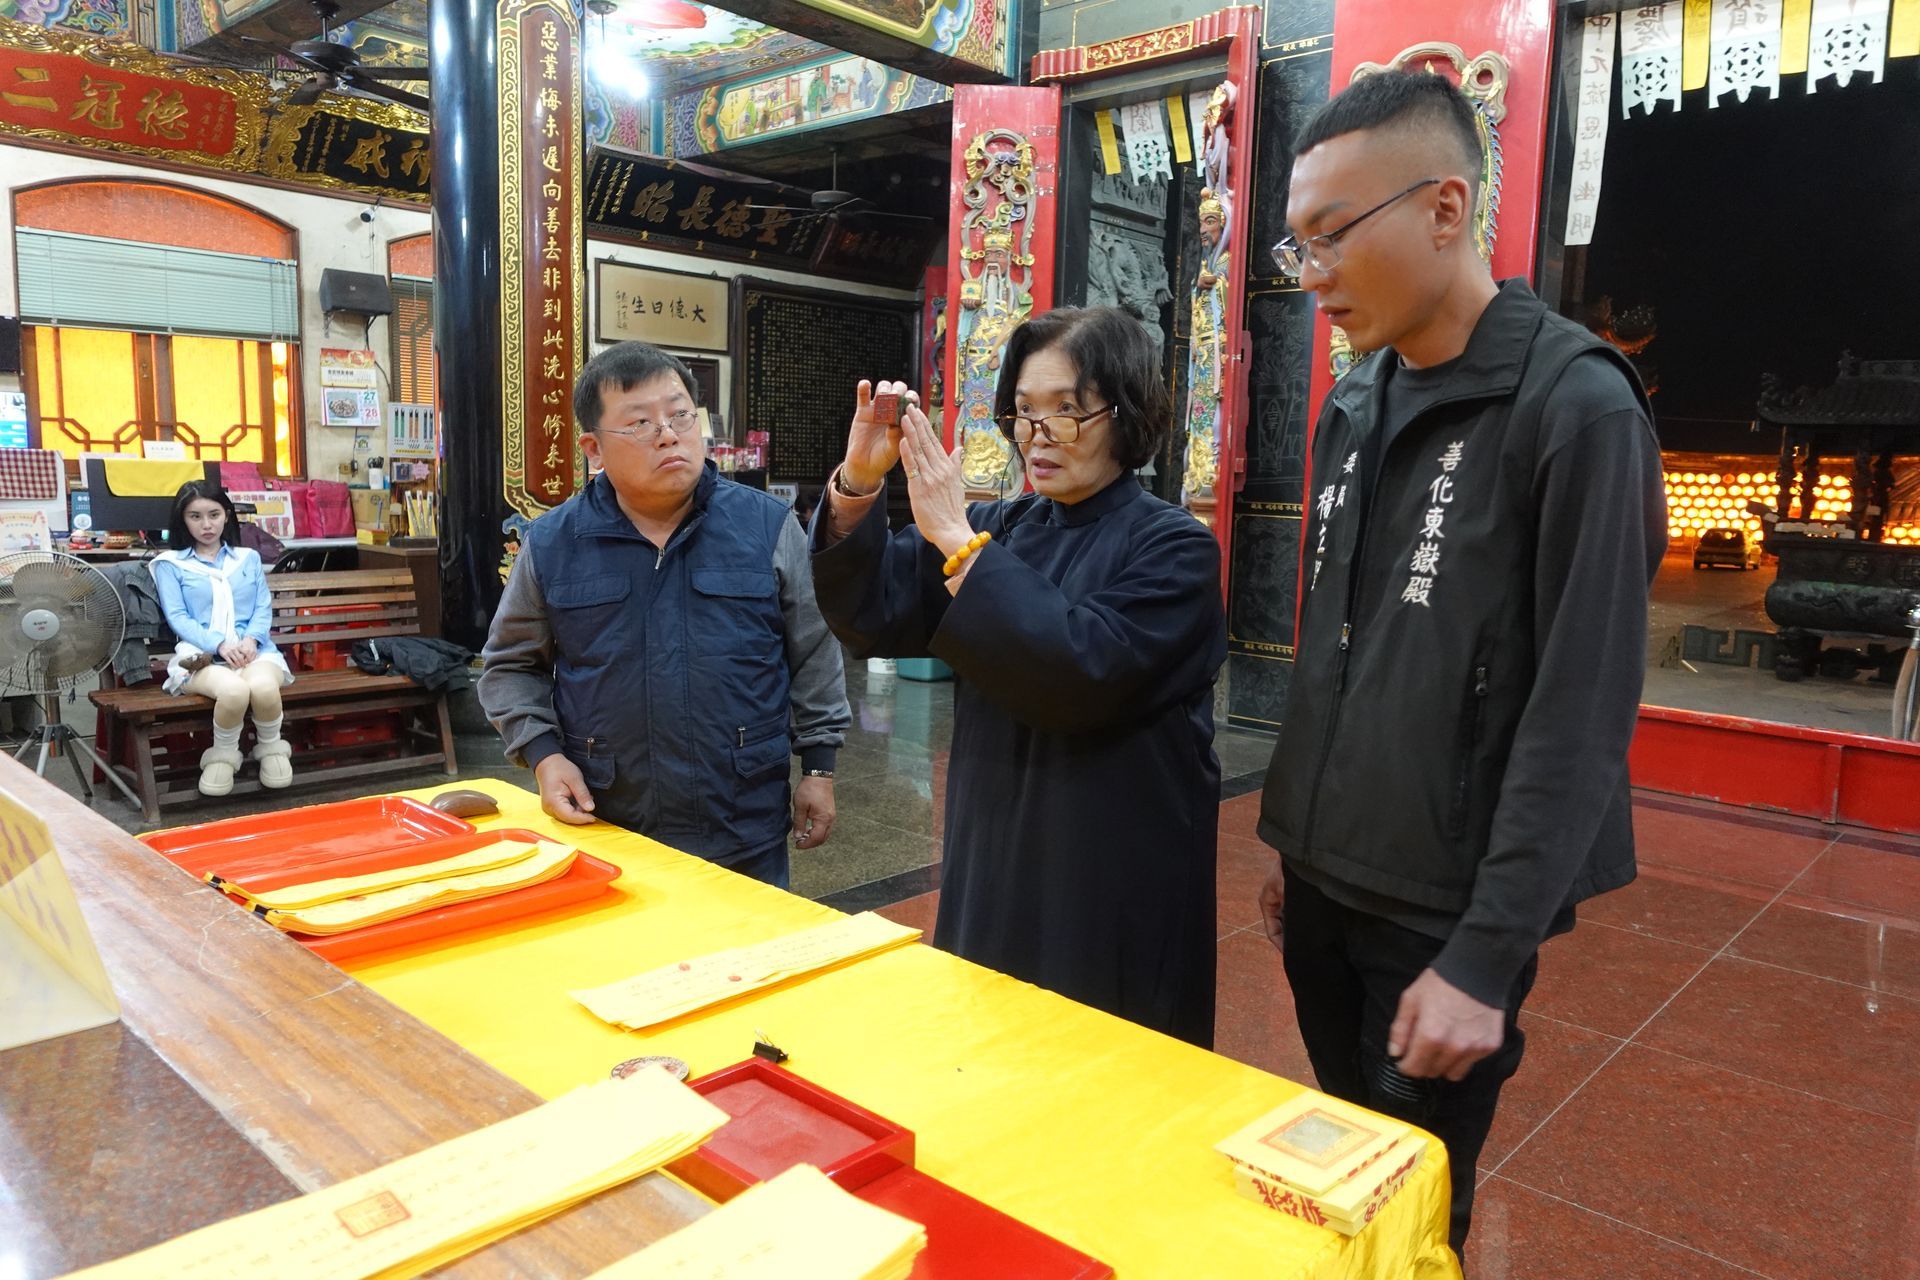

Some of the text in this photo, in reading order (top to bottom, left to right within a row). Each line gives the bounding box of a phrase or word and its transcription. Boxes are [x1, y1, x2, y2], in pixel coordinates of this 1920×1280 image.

[363, 391, 376, 401] 27
[1400, 440, 1465, 608] 善化東嶽殿
